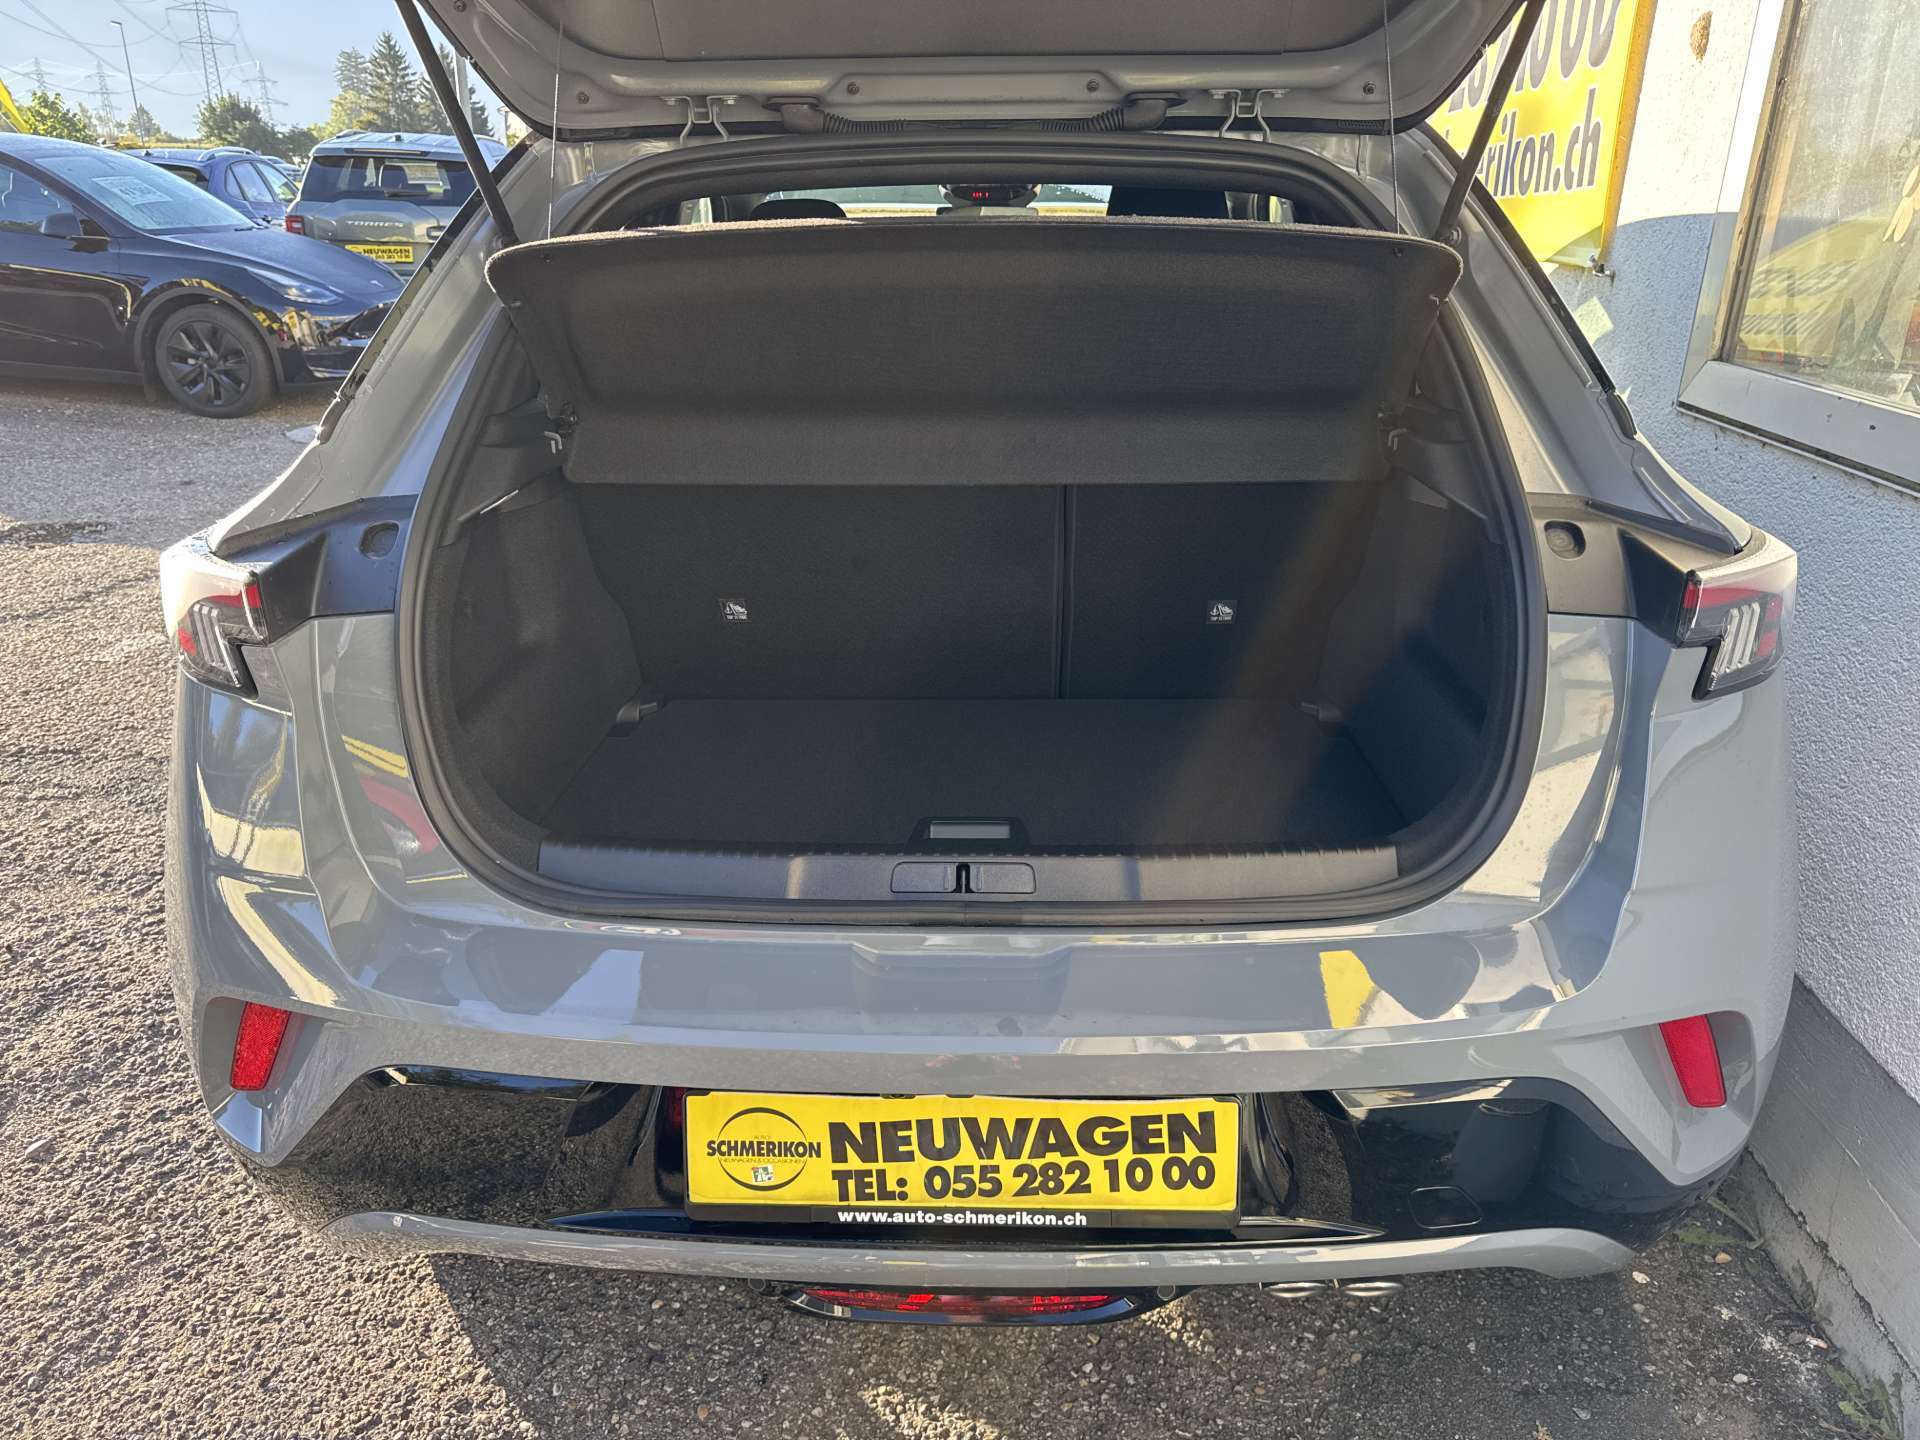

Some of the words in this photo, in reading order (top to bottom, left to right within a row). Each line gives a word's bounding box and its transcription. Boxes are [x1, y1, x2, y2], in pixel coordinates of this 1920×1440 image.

[706, 1140, 821, 1159] SCHMERIKON
[828, 1111, 1217, 1164] NEUWAGEN
[832, 1168, 908, 1202] TEL:
[923, 1164, 1003, 1199] 055
[1012, 1161, 1092, 1198] 282
[1103, 1157, 1154, 1193] 10
[1161, 1155, 1216, 1191] 00
[837, 1208, 1088, 1226] www.auto-schmerikon.ch
